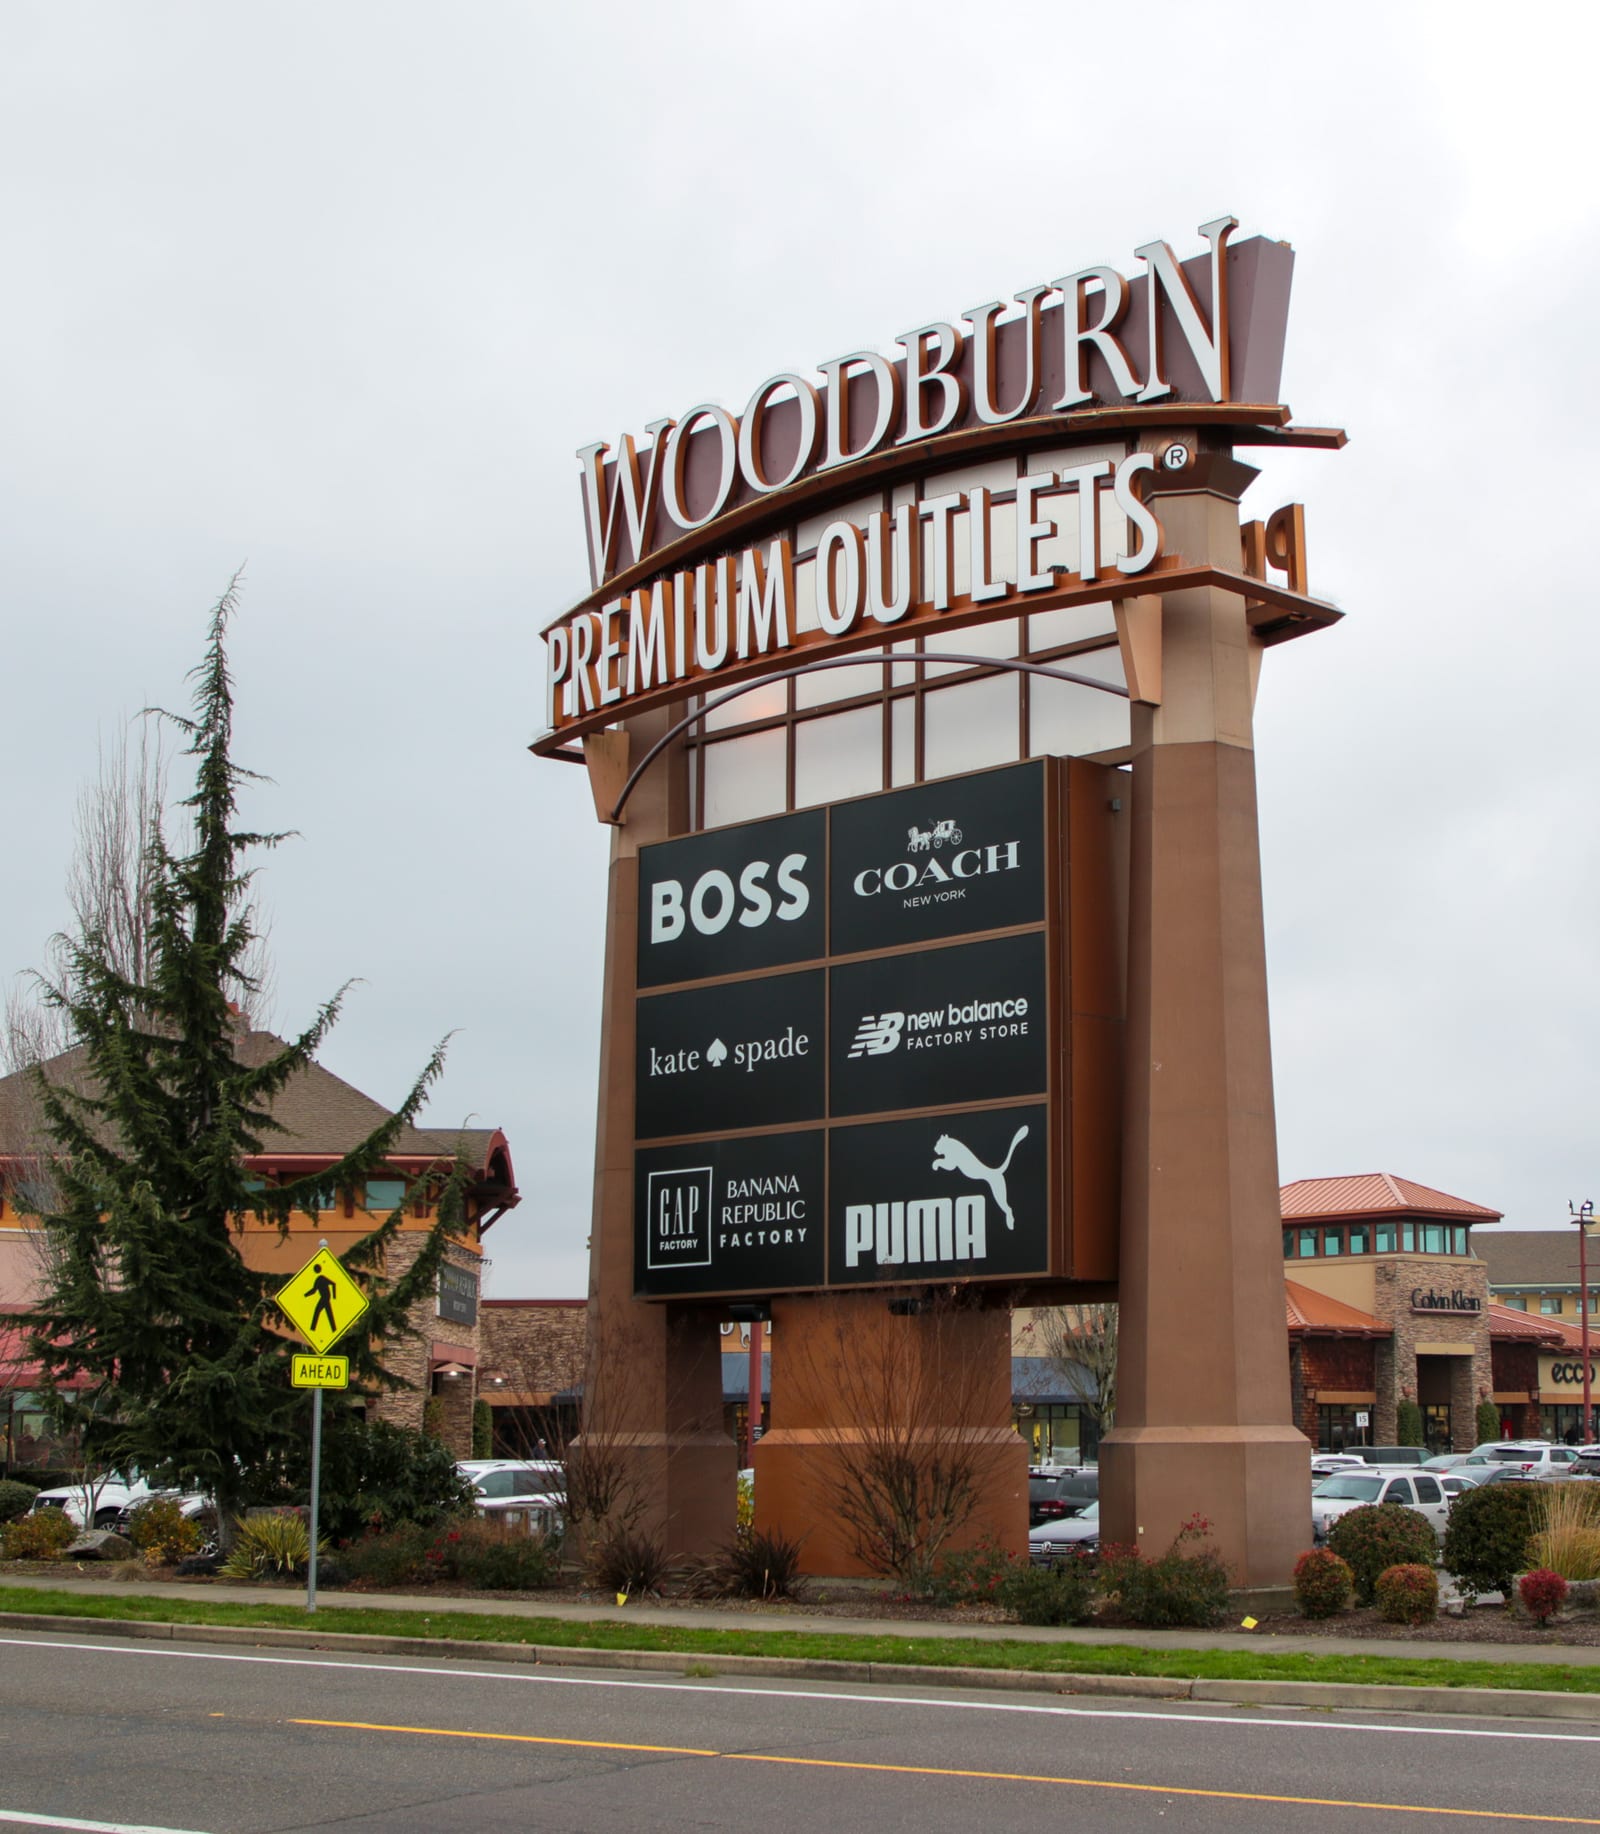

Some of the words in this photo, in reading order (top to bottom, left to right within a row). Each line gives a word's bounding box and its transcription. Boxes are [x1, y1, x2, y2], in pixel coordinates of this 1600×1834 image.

[575, 216, 1239, 587] WOODBURN
[546, 538, 795, 729] PREMIUM
[816, 451, 1165, 636] OUTLETS
[853, 840, 1021, 897] COACH
[650, 853, 810, 945] BOSS
[903, 895, 931, 909] NEW
[933, 888, 966, 903] YORK
[907, 1010, 944, 1031] new
[948, 998, 1028, 1026] balance
[650, 1047, 700, 1076] kate
[734, 1026, 809, 1073] spade
[907, 1030, 972, 1050] FACTORY
[980, 1022, 1028, 1040] STORE
[727, 1175, 800, 1199] BANANA
[660, 1186, 699, 1236] GAP
[722, 1200, 806, 1225] REPUBLIC
[659, 1239, 698, 1251] FACTORY
[719, 1228, 807, 1248] FACTORY
[845, 1195, 987, 1267] PUMA
[1411, 1288, 1450, 1309] Calvin
[1451, 1290, 1481, 1311] Klein
[300, 1363, 341, 1379] AHEAD
